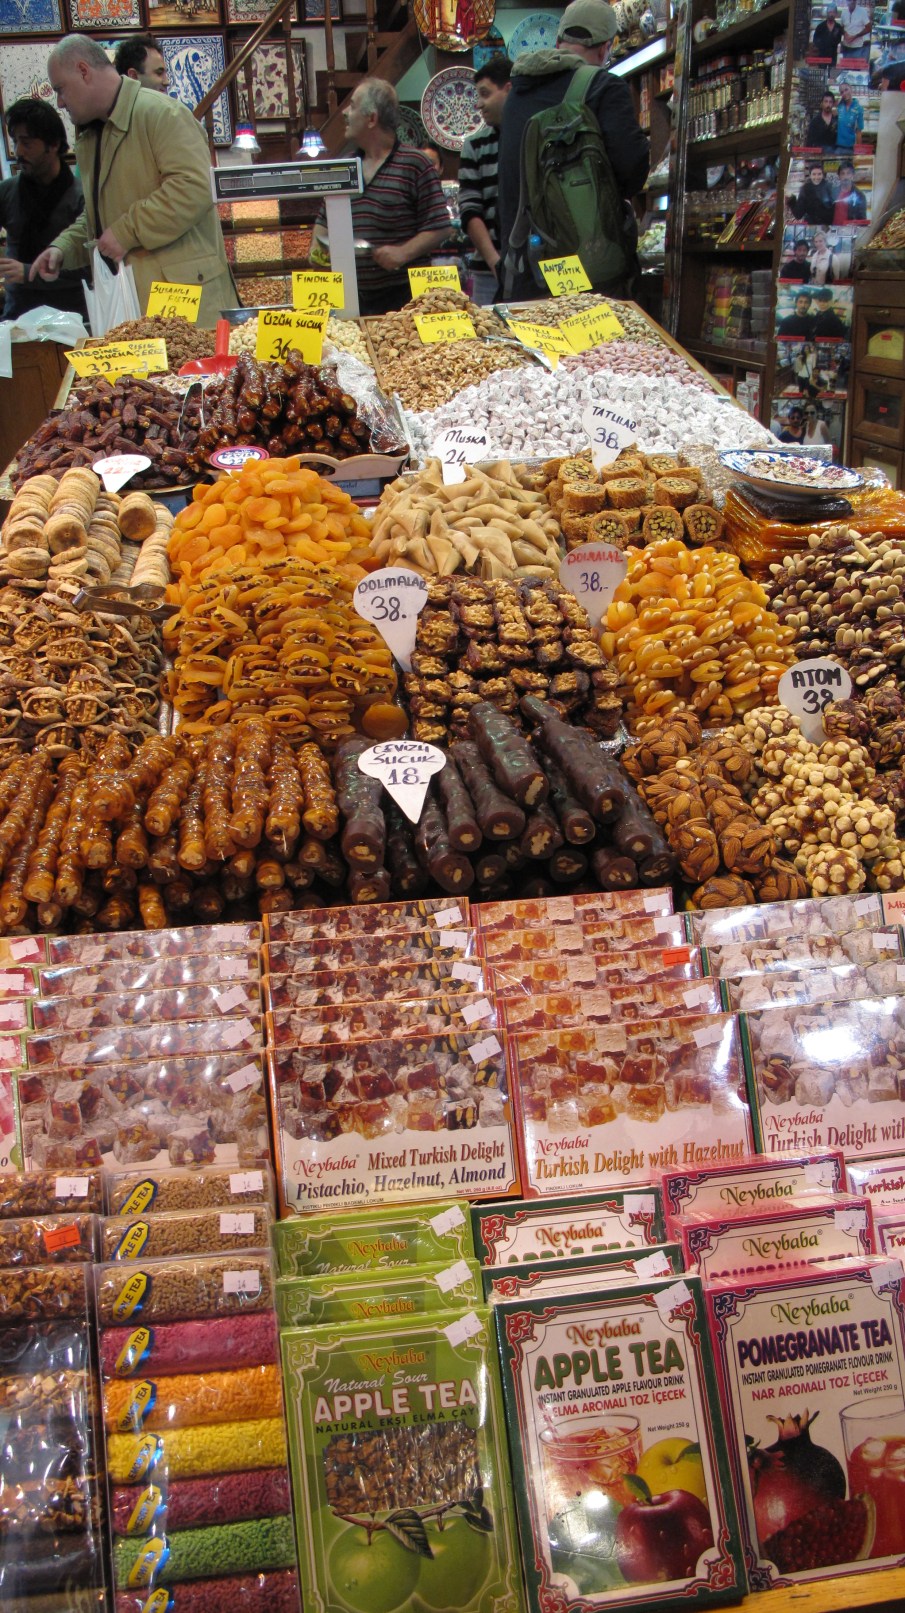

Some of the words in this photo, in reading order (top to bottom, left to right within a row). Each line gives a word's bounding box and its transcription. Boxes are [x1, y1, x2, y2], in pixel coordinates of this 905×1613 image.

[270, 338, 293, 359] 36
[358, 575, 428, 594] DOLMALAR
[790, 667, 842, 688] ATOM
[765, 1110, 823, 1132] Neybaba
[536, 1136, 589, 1156] Neybaba
[768, 1129, 822, 1152] Turkish
[827, 1122, 877, 1150] Delight
[293, 1156, 357, 1179] Neybaba
[368, 1149, 406, 1172] Mixed
[409, 1144, 458, 1168] Turkish
[460, 1140, 505, 1164] Delight
[535, 1154, 589, 1180] Turkish
[594, 1148, 644, 1176] Delight
[649, 1144, 678, 1167] with
[682, 1138, 744, 1163] Hazelnut
[137, 1186, 150, 1201] TEA
[296, 1178, 370, 1200] Pistachio,
[374, 1172, 445, 1192] Hazelnut,
[449, 1162, 506, 1186] Almond
[720, 1181, 794, 1206] Neybaba
[131, 1227, 144, 1242] TEA
[536, 1222, 604, 1248] Neybaba
[742, 1230, 820, 1260] Neybaba
[347, 1238, 408, 1258] Neybaba
[130, 1278, 143, 1294] TEA
[771, 1296, 850, 1326] Neybaba
[134, 1330, 148, 1344] TEA
[566, 1318, 642, 1347] Neybaba
[737, 1322, 860, 1369] POMEGRANATE
[860, 1317, 892, 1348] TEA
[360, 1348, 426, 1374] Neybaba
[534, 1346, 624, 1392] APPLE
[628, 1337, 685, 1377] TEA
[742, 1370, 766, 1385] INSTANT
[767, 1366, 804, 1382] GRANULATED
[806, 1358, 848, 1375] POMEGRANATE
[876, 1350, 894, 1363] DRINK
[136, 1386, 148, 1400] TEA
[324, 1374, 386, 1394] Natural
[392, 1370, 428, 1386] Sour
[538, 1390, 566, 1404] INSTANT
[568, 1386, 610, 1400] GRANULATED
[612, 1382, 632, 1394] APPLE
[634, 1378, 662, 1391] FLAVOUR
[664, 1374, 686, 1386] DRINK
[752, 1388, 775, 1402] NAR
[778, 1380, 826, 1398] AROMALI
[828, 1376, 850, 1389] TOZ
[852, 1370, 889, 1387] İÇECEK
[853, 1388, 862, 1396] Net
[863, 1386, 882, 1395] Weight
[314, 1386, 411, 1424] APPLE
[418, 1379, 478, 1410] TEA
[552, 1405, 579, 1418] ELMA
[582, 1397, 627, 1414] AROMALI
[630, 1394, 650, 1406] TOZ
[652, 1388, 686, 1404] İÇECEK
[316, 1420, 374, 1434] NATURAL
[412, 1412, 446, 1422] ELMA
[658, 1423, 676, 1432] Weight
